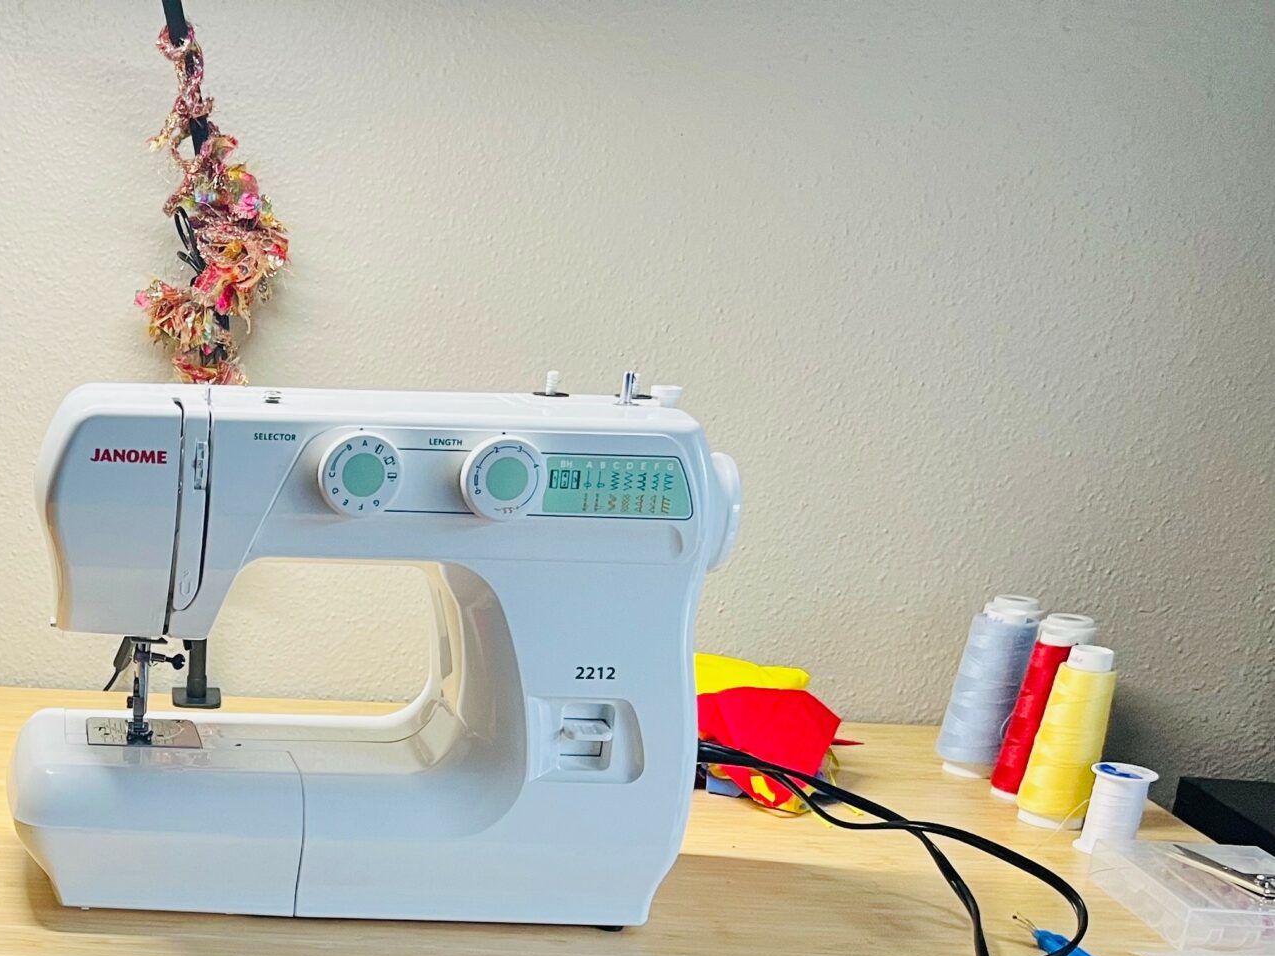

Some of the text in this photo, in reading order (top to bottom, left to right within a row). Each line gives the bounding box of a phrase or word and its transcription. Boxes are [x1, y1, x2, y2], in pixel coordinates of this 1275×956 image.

[253, 432, 296, 441] SELECTOR
[362, 439, 368, 447] A
[429, 438, 463, 446] LENGTH
[90, 448, 167, 465] JANOME
[586, 461, 593, 469] A
[612, 462, 620, 470] C
[640, 463, 647, 471] E
[654, 463, 660, 471] F
[575, 666, 616, 680] 2212
